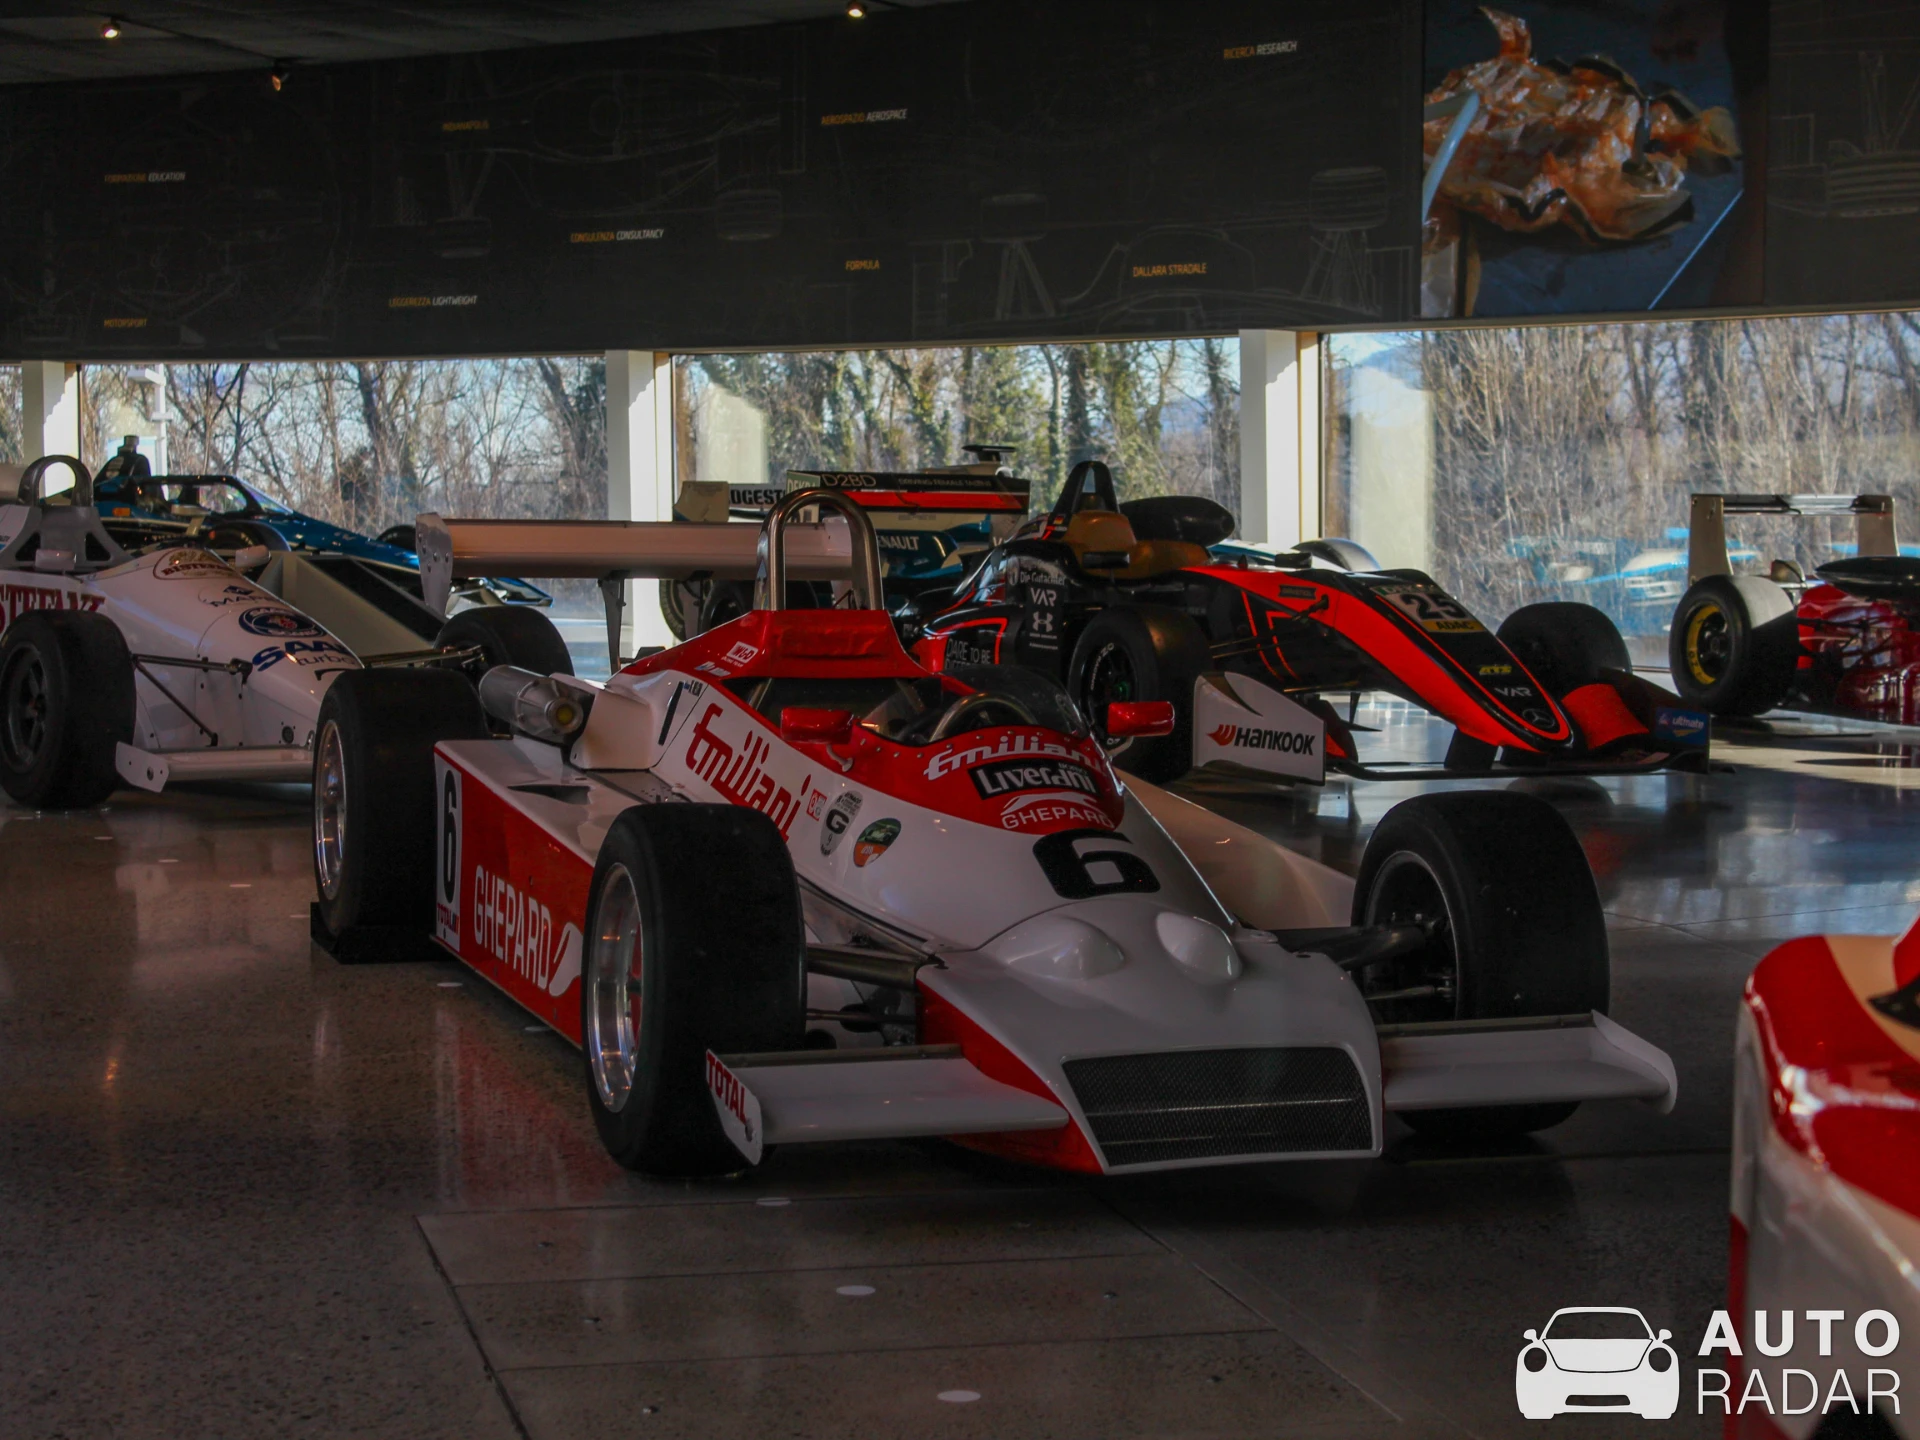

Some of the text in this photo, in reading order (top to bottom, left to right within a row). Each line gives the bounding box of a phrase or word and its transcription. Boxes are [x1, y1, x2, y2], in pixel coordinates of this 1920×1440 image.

[1223, 41, 1298, 59] RICERCA RESEARCH
[866, 108, 908, 122] AEROSPACE
[148, 172, 186, 182] EDUCATION
[616, 229, 665, 241] CONSULTANCY
[845, 259, 880, 271] FORMULA
[1132, 262, 1208, 278] DALLARA STRADALE
[432, 294, 478, 306] LIGHTWEIGHT
[103, 317, 148, 328] MOTORSPORT
[1030, 587, 1057, 607] VAR
[1401, 593, 1467, 619] 25
[1436, 620, 1475, 630] ADAC
[1493, 687, 1532, 697] VAR
[443, 769, 457, 904] 6
[1032, 828, 1161, 899] 6
[473, 864, 552, 990] GHEPARD
[707, 1052, 747, 1125] TOTAL
